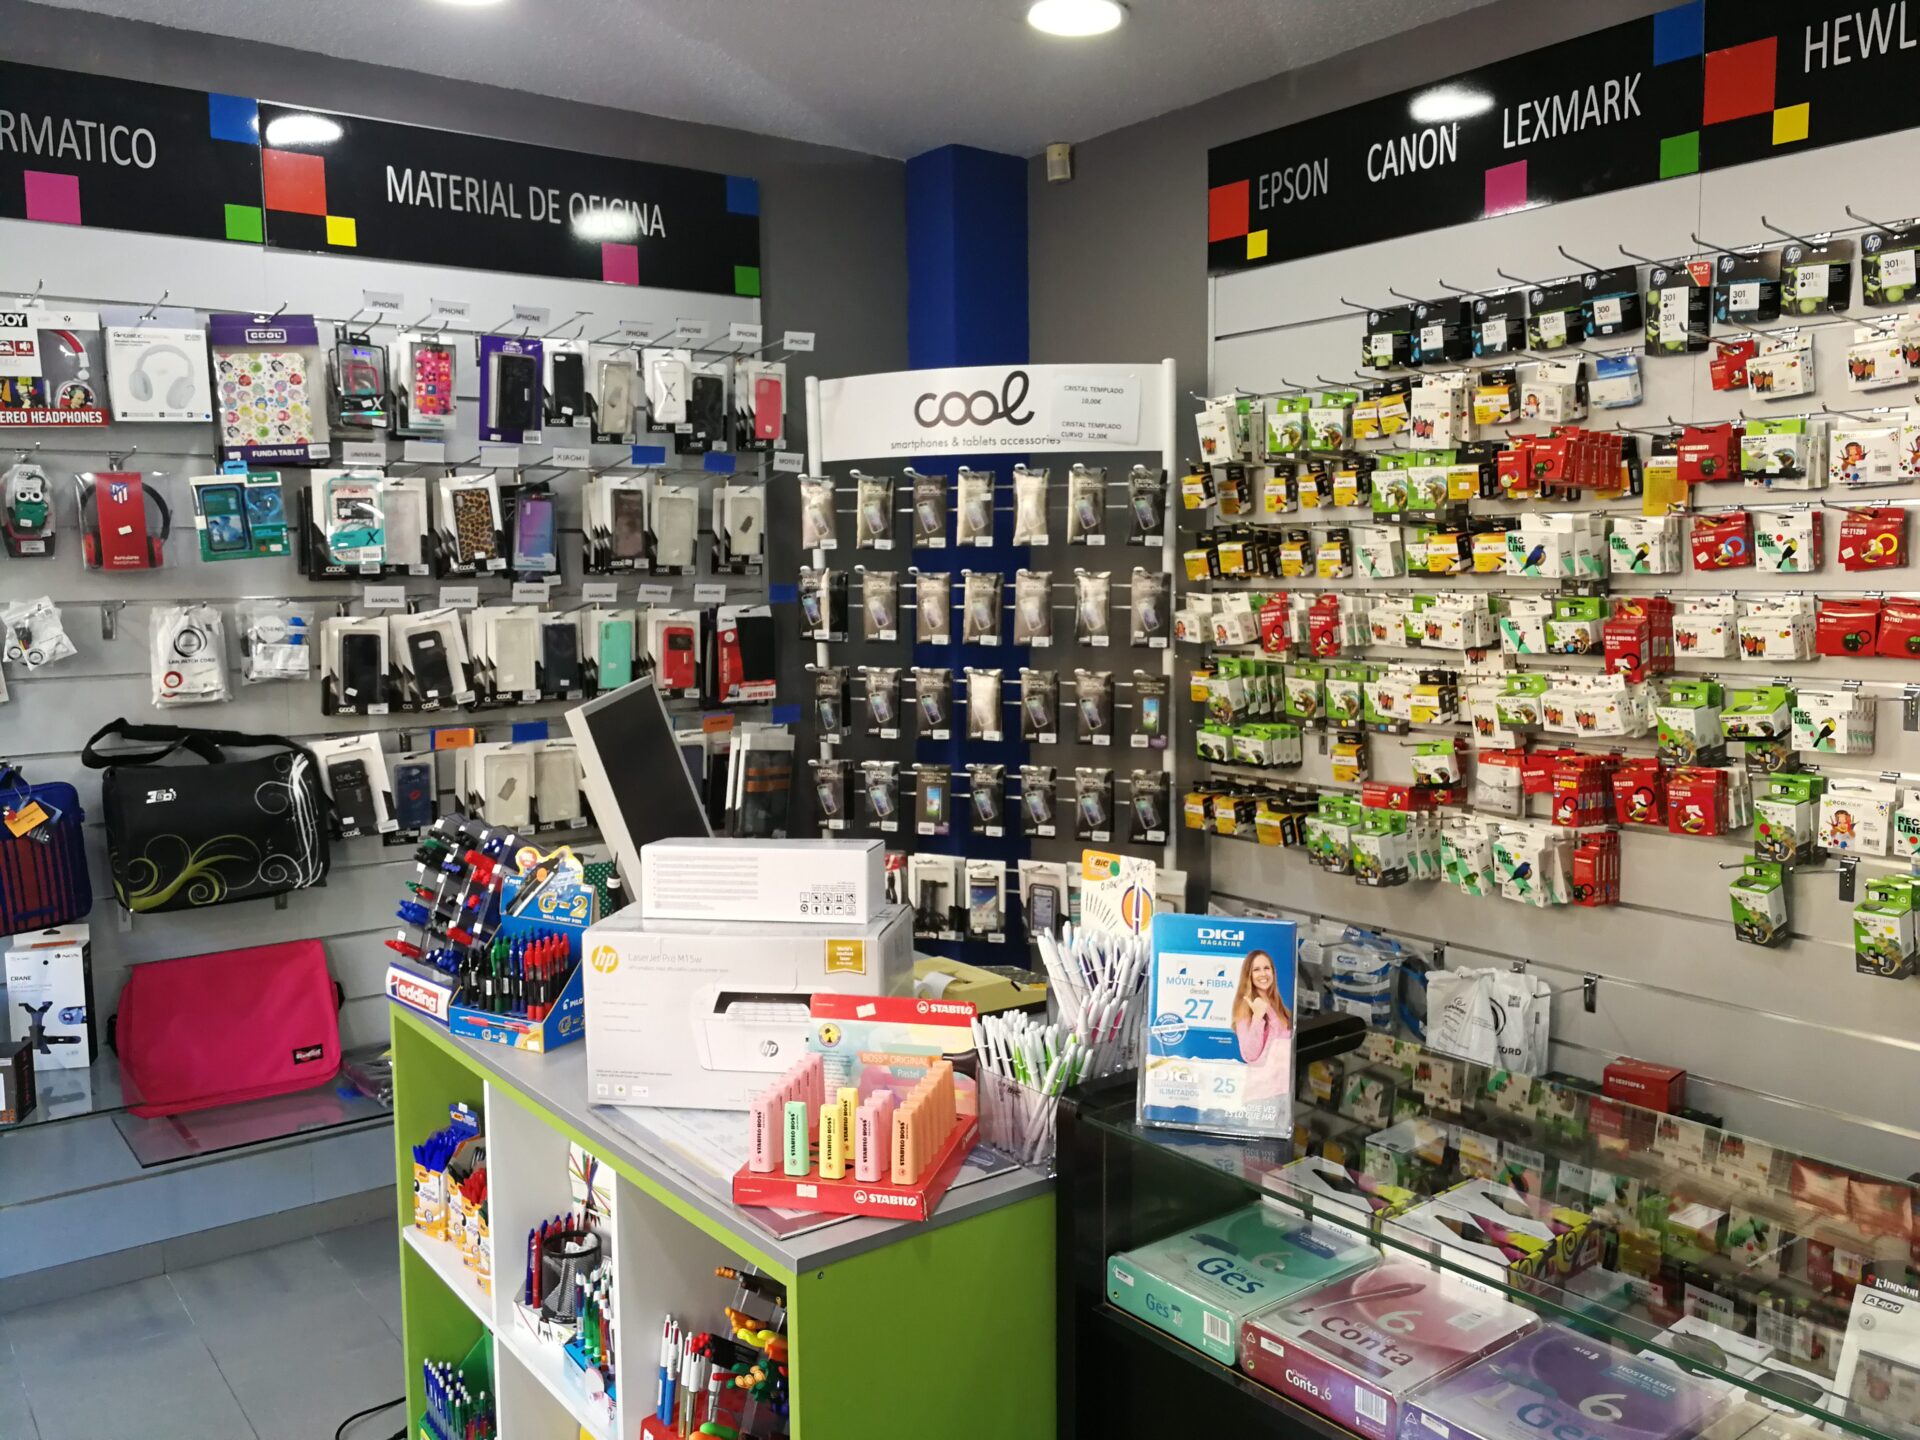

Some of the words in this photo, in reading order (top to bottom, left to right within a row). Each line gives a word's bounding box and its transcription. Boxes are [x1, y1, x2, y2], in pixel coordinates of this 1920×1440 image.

[1502, 71, 1642, 149] LEXMARK
[1366, 122, 1458, 184] CANON
[1258, 157, 1329, 211] EPSON
[385, 164, 522, 220] MATERIAL
[529, 186, 562, 225] DE
[1884, 258, 1900, 269] 301
[1800, 272, 1814, 281] 301
[1663, 293, 1676, 302] 301
[1733, 290, 1746, 299] 301
[371, 300, 400, 310] IPHONE
[1596, 304, 1610, 314] 300
[438, 307, 465, 316] IPHONE
[515, 312, 541, 323] IPHONE
[1662, 313, 1675, 322] 301
[680, 326, 702, 334] IPHONE
[1423, 328, 1435, 337] 305
[1063, 384, 1089, 392] CRISTAL
[1090, 386, 1125, 395] TEMPLADO
[913, 369, 1036, 429] cool
[30, 410, 103, 425] HEADPHONES
[1061, 420, 1086, 428] CRISTAL
[1087, 421, 1122, 430] TEMPLADO
[890, 437, 949, 452] smartphones
[951, 437, 960, 448] &
[962, 435, 998, 447] tablets
[999, 435, 1062, 446] accessories
[252, 450, 278, 459] FUNDA
[278, 448, 305, 458] TABLET
[1508, 536, 1524, 544] REC
[1757, 540, 1776, 548] LINE
[1508, 544, 1526, 553] LINE
[1794, 710, 1811, 718] REC
[1794, 717, 1813, 726] LINE
[1897, 815, 1920, 826] REC
[1094, 858, 1109, 869] BIC
[538, 892, 589, 919] G-2
[1197, 927, 1245, 941] DIGI
[1200, 939, 1241, 947] MAGAZINE
[594, 948, 617, 974] hp
[628, 953, 662, 963] LaserJet
[662, 954, 677, 963] Pro
[678, 954, 703, 964] M15w
[1166, 974, 1196, 986] MÓVIL
[1206, 979, 1234, 989] FIBRA
[398, 980, 438, 1012] edding
[929, 1003, 974, 1016] STABILO
[1184, 998, 1214, 1020] 27
[889, 1055, 929, 1067] ORIGINAL
[897, 1068, 920, 1079] Pastel
[1213, 1077, 1236, 1094] 25
[869, 1193, 918, 1207] STABILO
[1197, 1257, 1265, 1295] Ges
[1875, 1277, 1920, 1299] Kingston
[1145, 1293, 1169, 1319] Ges
[1376, 1310, 1425, 1334] 6
[1320, 1316, 1414, 1367] Conta
[1285, 1369, 1319, 1396] Conta
[1578, 1393, 1629, 1423] 6
